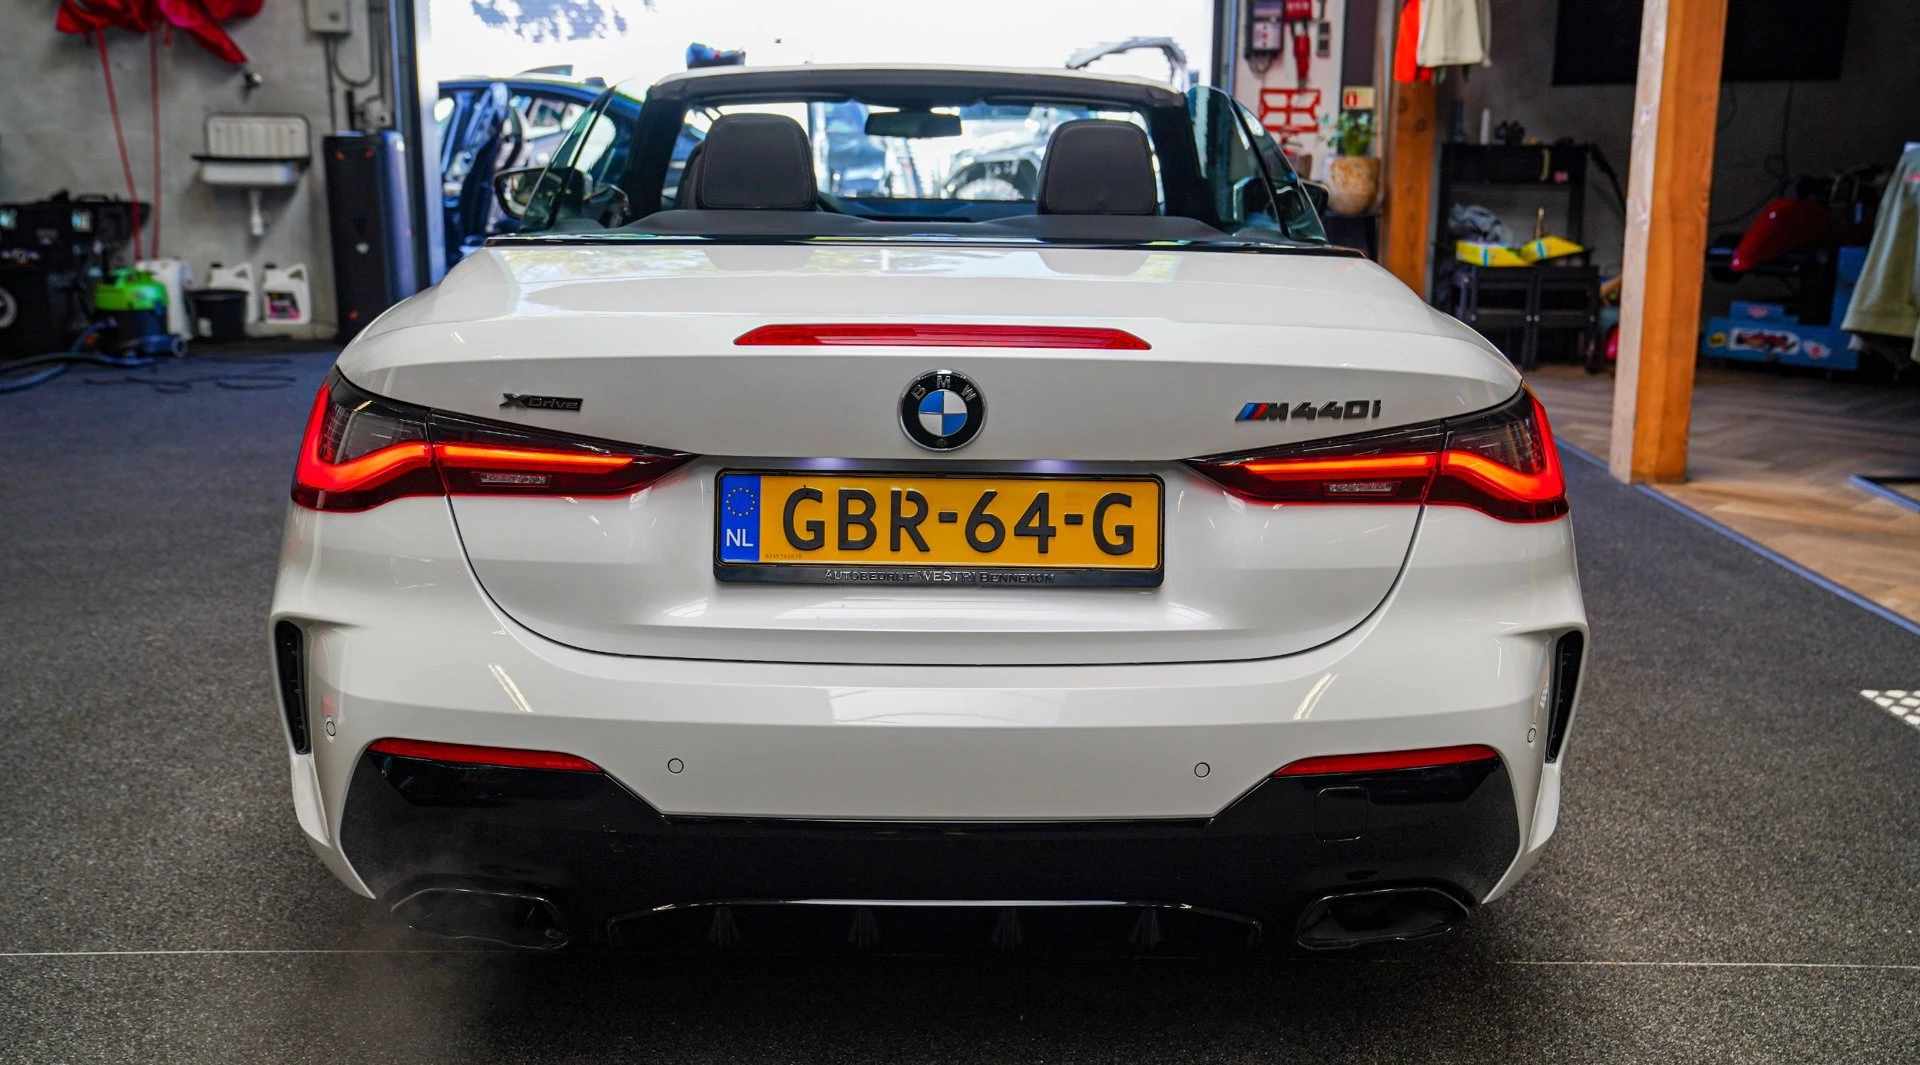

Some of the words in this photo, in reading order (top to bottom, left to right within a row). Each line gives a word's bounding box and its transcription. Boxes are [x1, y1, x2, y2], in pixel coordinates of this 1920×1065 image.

[910, 375, 977, 402] BMW
[1260, 399, 1381, 421] M440i
[782, 487, 1136, 555] GBR-64-G
[726, 528, 754, 547] NL
